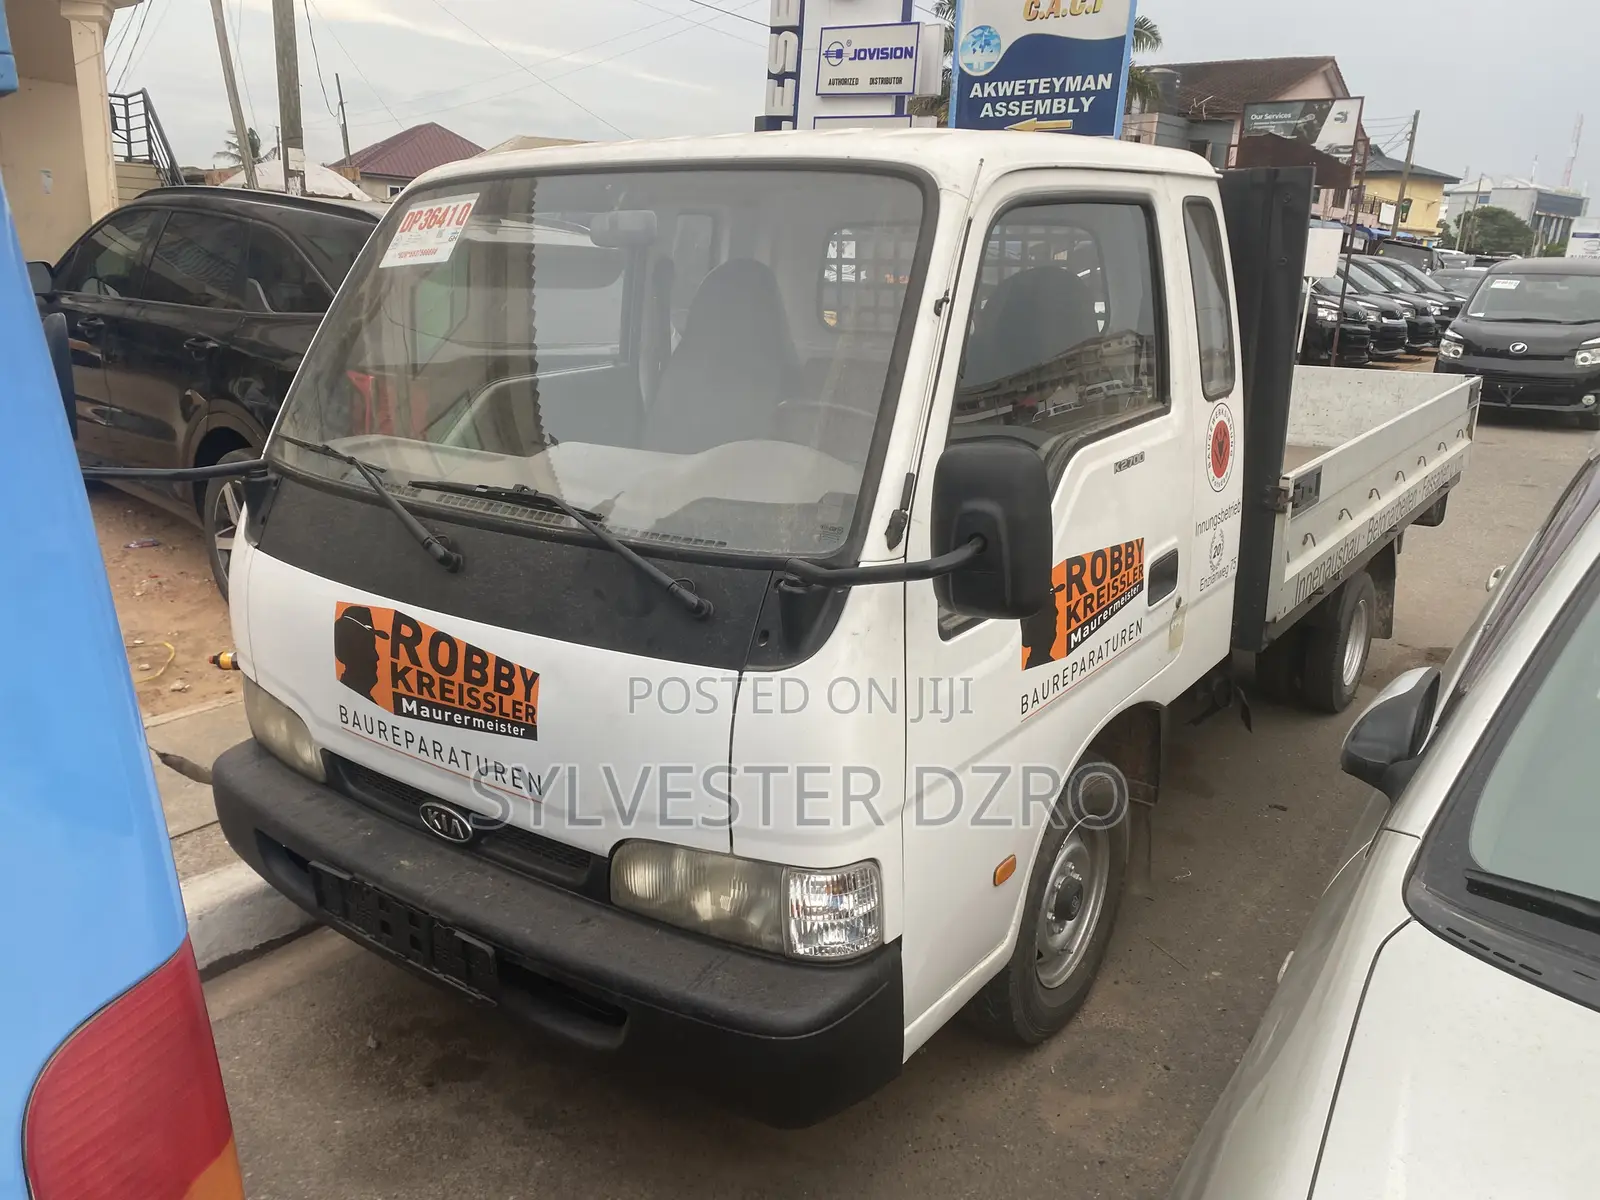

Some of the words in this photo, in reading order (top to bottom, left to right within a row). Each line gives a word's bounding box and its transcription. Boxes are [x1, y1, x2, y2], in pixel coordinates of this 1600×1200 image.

[848, 46, 914, 61] JOVISION
[828, 78, 859, 86] AUTHORIZED
[869, 76, 903, 85] DISTRIBUTOR
[969, 73, 1113, 98] AKWETEYMAN
[980, 96, 1095, 118] ASSEMBLY
[1264, 112, 1291, 120] Services
[1113, 450, 1145, 475] K2700
[1195, 499, 1241, 537] Innungsbetrieb
[1066, 537, 1144, 602] ROBBY
[1212, 543, 1222, 559] 20
[1295, 532, 1361, 605] Innenausbau
[1066, 563, 1144, 631] KREISSLER
[1070, 583, 1140, 649] Maurermeister
[390, 610, 540, 702] ROBBY
[1021, 617, 1143, 715] BAUREPARATUREN
[391, 661, 537, 724] KREISSLER
[401, 697, 526, 736] Maurermeister
[338, 704, 543, 795] BAUREPARATUREN
[425, 806, 467, 841] KIA
